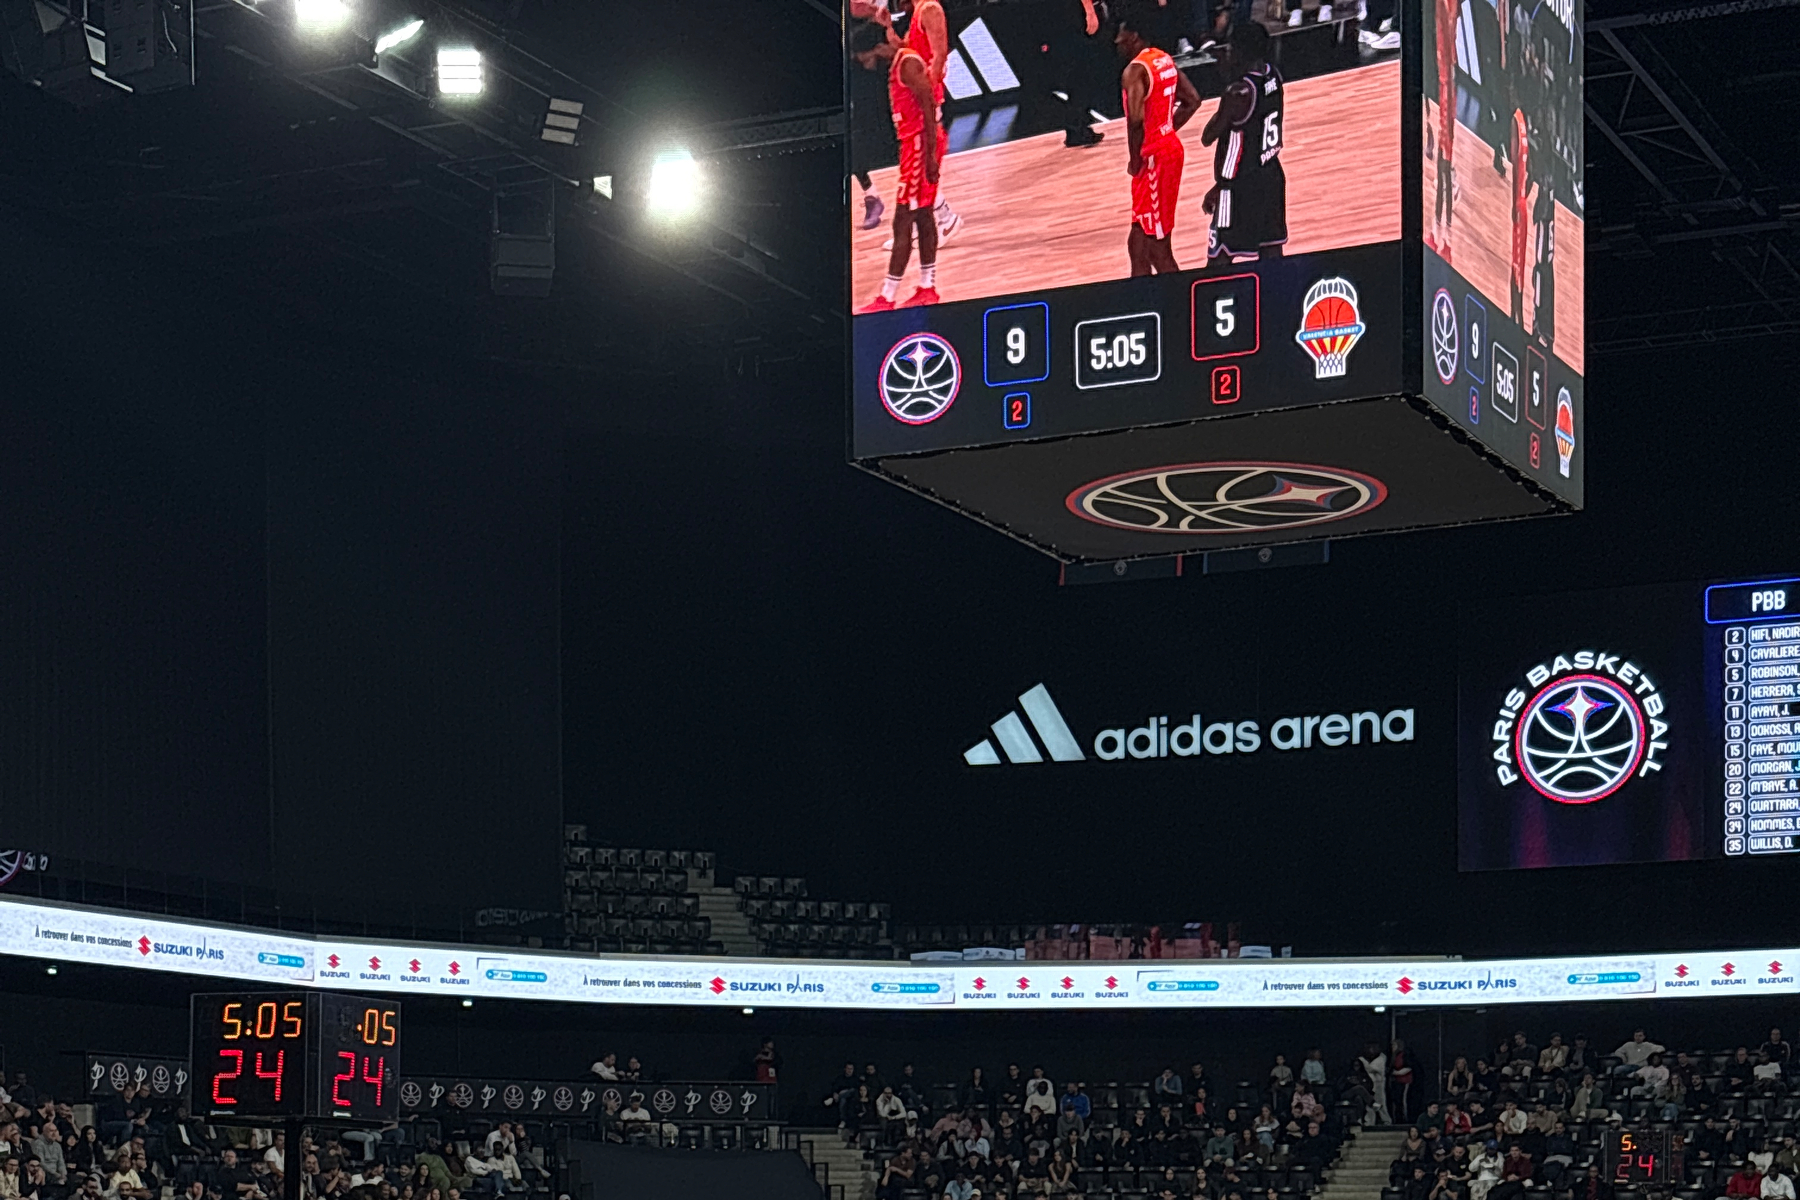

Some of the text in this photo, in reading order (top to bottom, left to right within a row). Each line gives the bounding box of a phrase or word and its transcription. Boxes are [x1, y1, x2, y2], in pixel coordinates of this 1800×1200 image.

[1263, 111, 1278, 151] 15
[1215, 299, 1235, 337] 5
[1006, 327, 1026, 364] 9
[1471, 322, 1480, 360] 9
[1090, 332, 1146, 371] 5:05
[1219, 374, 1231, 396] 2
[1496, 363, 1514, 404] 5:05
[1532, 370, 1541, 407] 5
[1011, 400, 1023, 422] 2
[1471, 395, 1477, 416] 2
[1531, 440, 1538, 459] 2
[1751, 590, 1786, 612] PBB
[1731, 630, 1739, 643] 2
[1731, 649, 1739, 661] 4
[1731, 668, 1739, 681] 5
[1731, 688, 1739, 700] 7
[1493, 651, 1668, 786] PARIS BASKETBALL
[1731, 707, 1740, 719] 11
[1094, 707, 1415, 760] adidas arena
[1729, 726, 1741, 738] 13
[1729, 745, 1740, 757] 15
[1728, 764, 1741, 776] 20
[1728, 783, 1741, 795] 22
[1728, 802, 1741, 814] 24
[1728, 821, 1741, 833] 34
[1728, 840, 1741, 852] 35
[70, 930, 85, 943] dans
[97, 933, 133, 949] concessions
[153, 942, 193, 957] SUZUKI
[196, 937, 225, 960] PARIS
[320, 970, 350, 978] SUZUKI
[359, 972, 391, 981] SUZUKI
[400, 974, 431, 983] SUZUKI
[440, 977, 470, 985] SUZUKI
[590, 977, 622, 988] retrouver
[623, 978, 641, 988] dans
[642, 980, 656, 989] vos
[657, 979, 702, 989] concessions
[730, 981, 781, 992] SUZUKI
[786, 973, 824, 994] PARIS
[1270, 981, 1306, 991] retrouver
[1307, 980, 1325, 990] dans
[1326, 982, 1341, 990] vos
[1342, 979, 1389, 990] concessions
[1417, 980, 1472, 991] SUZUKI
[1477, 970, 1517, 990] PARIS
[1757, 976, 1793, 984] SUZUKI
[1051, 991, 1084, 999] SUZUKI
[212, 1049, 284, 1104] 24
[332, 1051, 384, 1106] 24
[1616, 1154, 1654, 1178] 24
